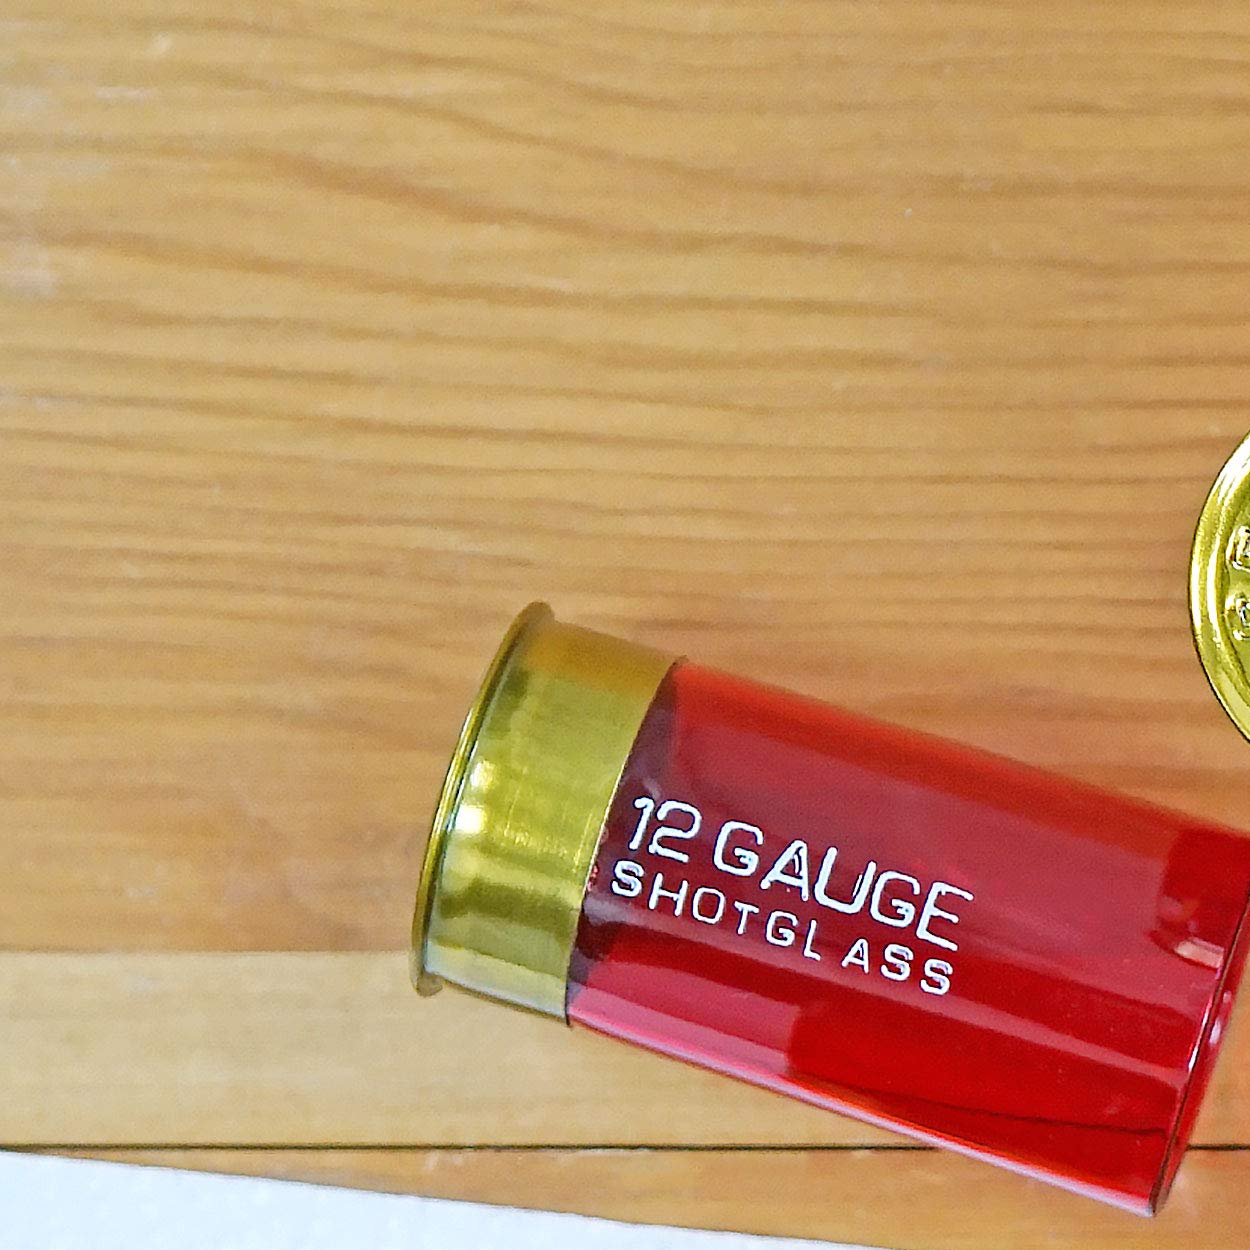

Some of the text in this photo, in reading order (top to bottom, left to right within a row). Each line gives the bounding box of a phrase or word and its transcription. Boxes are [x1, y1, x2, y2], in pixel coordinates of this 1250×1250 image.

[611, 859, 954, 996] SHOTGLASS
[628, 796, 974, 952] 12 GAUGE
